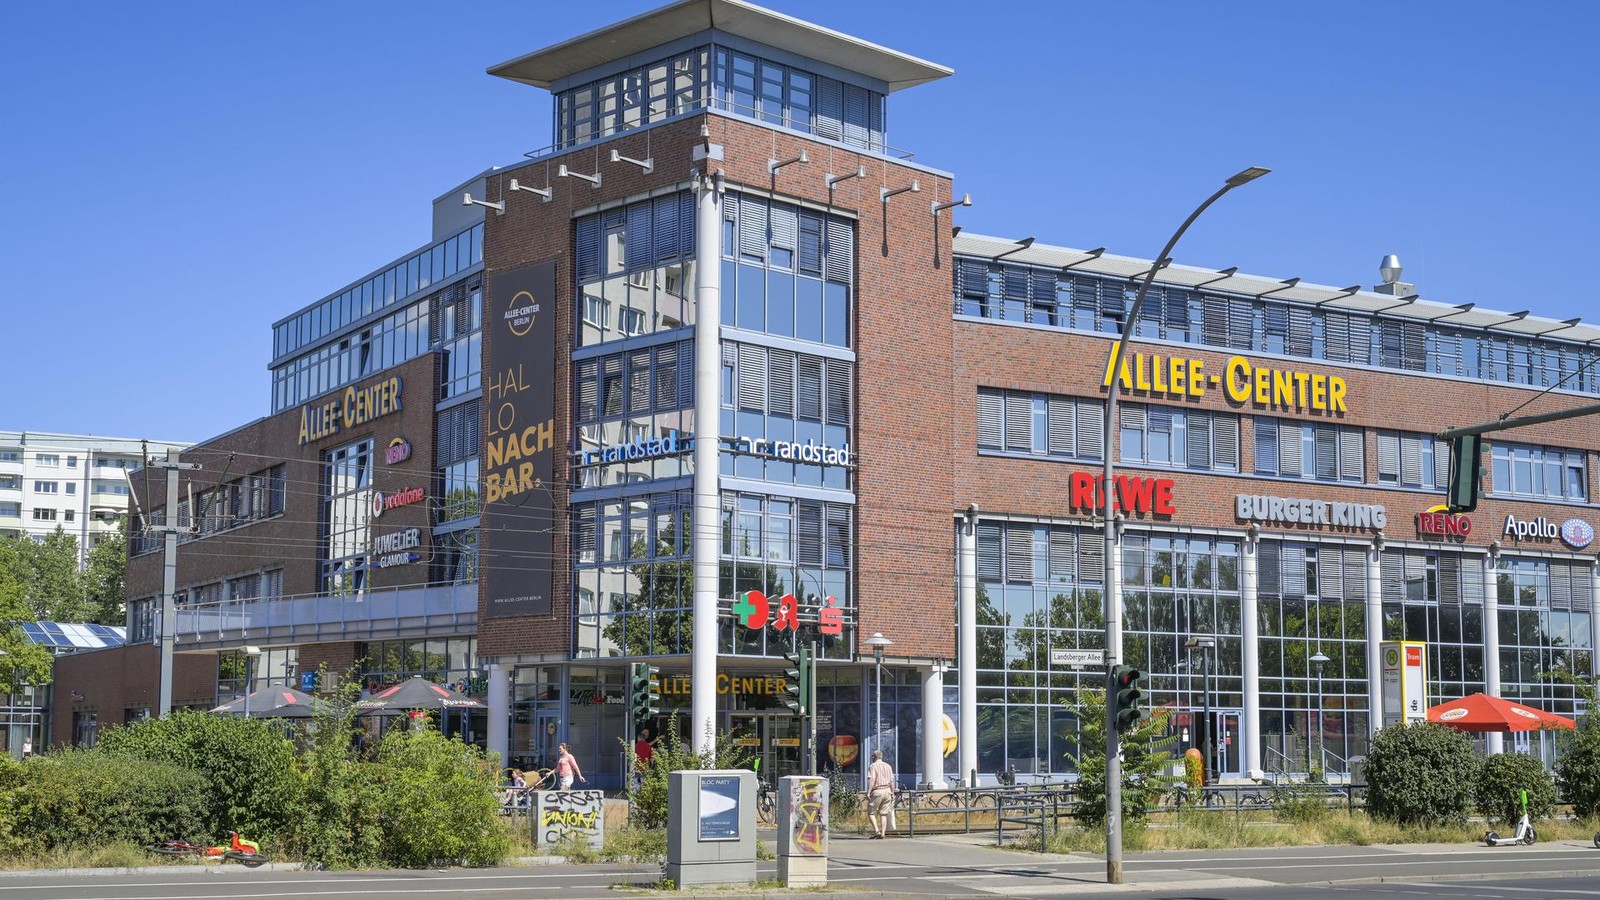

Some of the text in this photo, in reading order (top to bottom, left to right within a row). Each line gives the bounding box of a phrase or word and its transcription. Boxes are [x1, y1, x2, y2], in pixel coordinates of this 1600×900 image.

[504, 304, 540, 319] ALLEE-CENTER
[514, 316, 530, 326] BERLIN
[488, 364, 530, 403] HAL
[1103, 340, 1348, 411] ALLEE-CENTER
[298, 377, 402, 445] ALLEE-CENTER
[488, 402, 515, 436] LO
[487, 419, 554, 469] NACH
[604, 430, 676, 462] randstad
[774, 438, 849, 465] randstad
[487, 461, 541, 504] BAR.
[1070, 472, 1176, 515] REWE
[384, 486, 425, 509] vodafone
[1236, 494, 1387, 529] BURGER KING
[1419, 512, 1473, 536] RENO
[1505, 514, 1557, 540] Apollo
[373, 528, 420, 555] JUWELIER
[380, 552, 409, 568] GLAMOUR
[1053, 652, 1101, 662] Landsberger Allee
[649, 674, 692, 694] ALLE
[606, 695, 625, 704] Food
